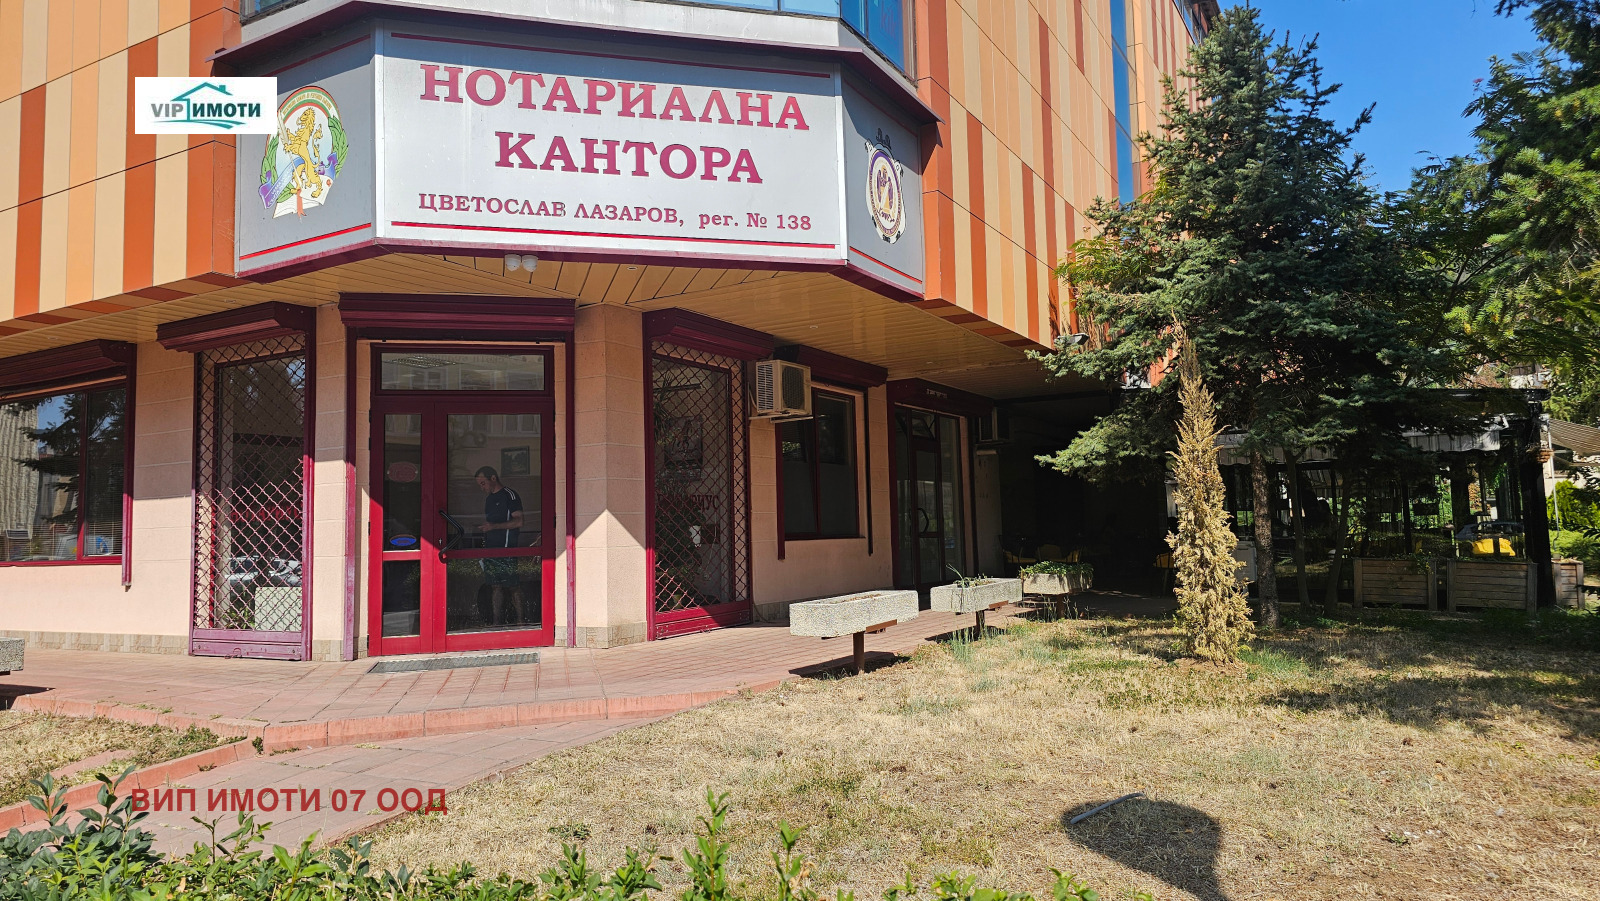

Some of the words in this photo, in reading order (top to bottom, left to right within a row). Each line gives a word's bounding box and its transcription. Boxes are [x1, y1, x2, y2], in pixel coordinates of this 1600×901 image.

[420, 63, 810, 131] НОТАРИАЛНА
[495, 131, 763, 184] КАНТОРА
[418, 193, 566, 218] ЦВЕТОСЛАВ
[574, 203, 685, 228] ЛАЗАРОВ,
[698, 213, 739, 230] рег.
[746, 212, 769, 229] №
[776, 214, 812, 231] 138
